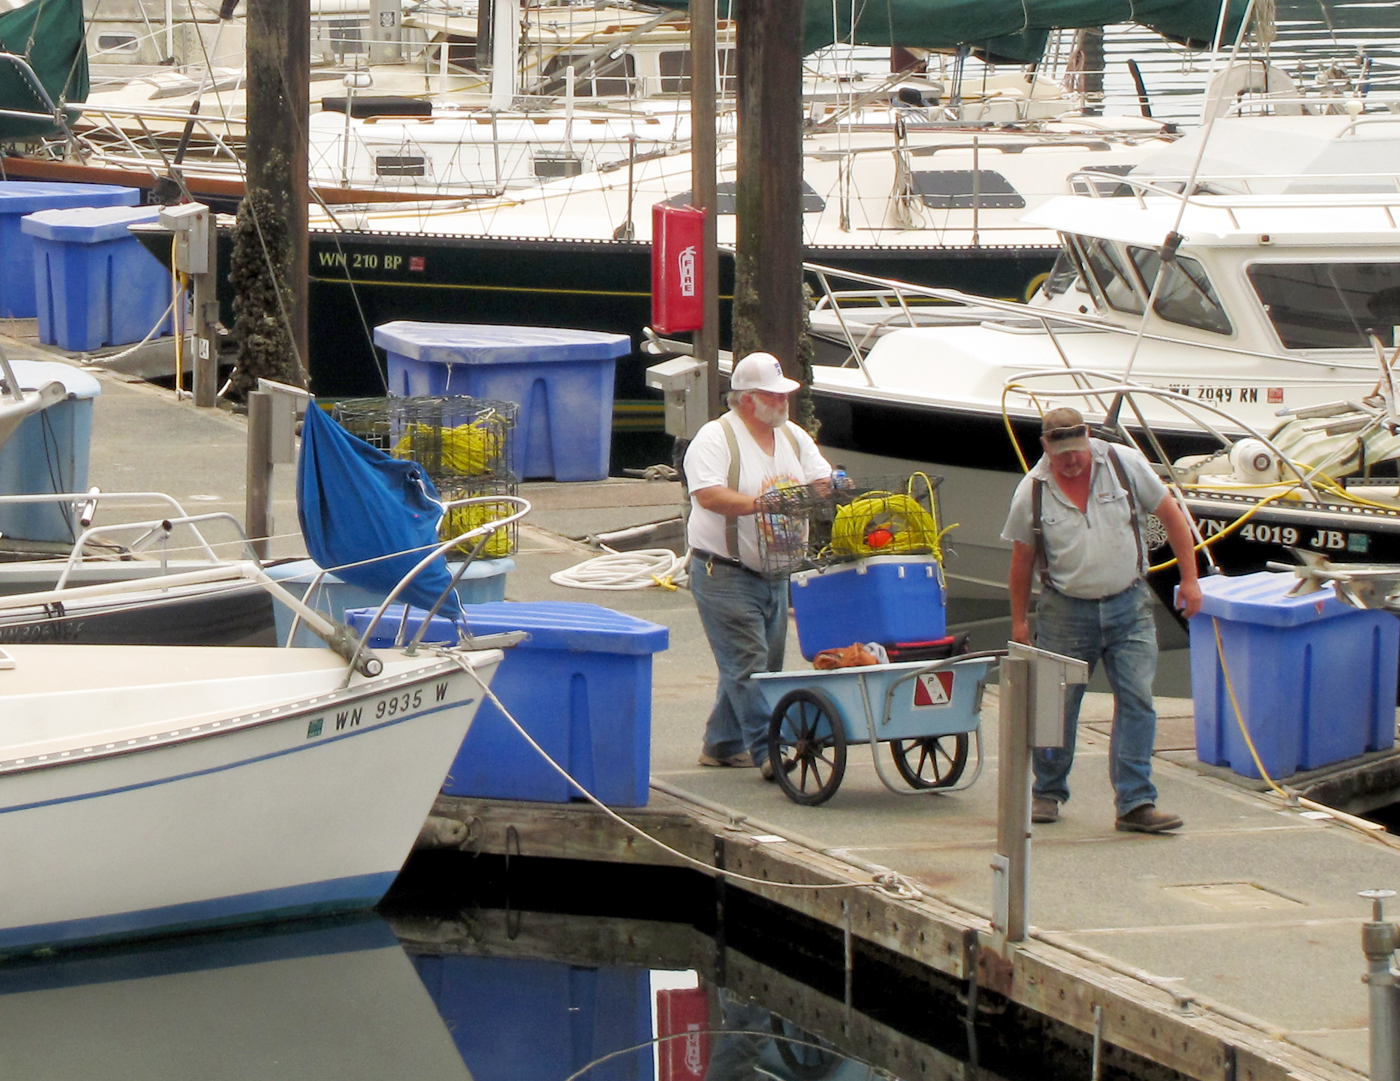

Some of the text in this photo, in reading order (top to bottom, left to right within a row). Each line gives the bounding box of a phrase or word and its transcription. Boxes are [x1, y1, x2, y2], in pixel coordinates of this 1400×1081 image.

[319, 251, 403, 270] WN 210 BP
[684, 259, 692, 292] FIRE
[1198, 384, 1233, 403] 2049
[1239, 385, 1258, 403] RN
[1239, 523, 1298, 545] 4019
[1310, 529, 1346, 549] JB
[335, 682, 449, 731] WN 9935 W
